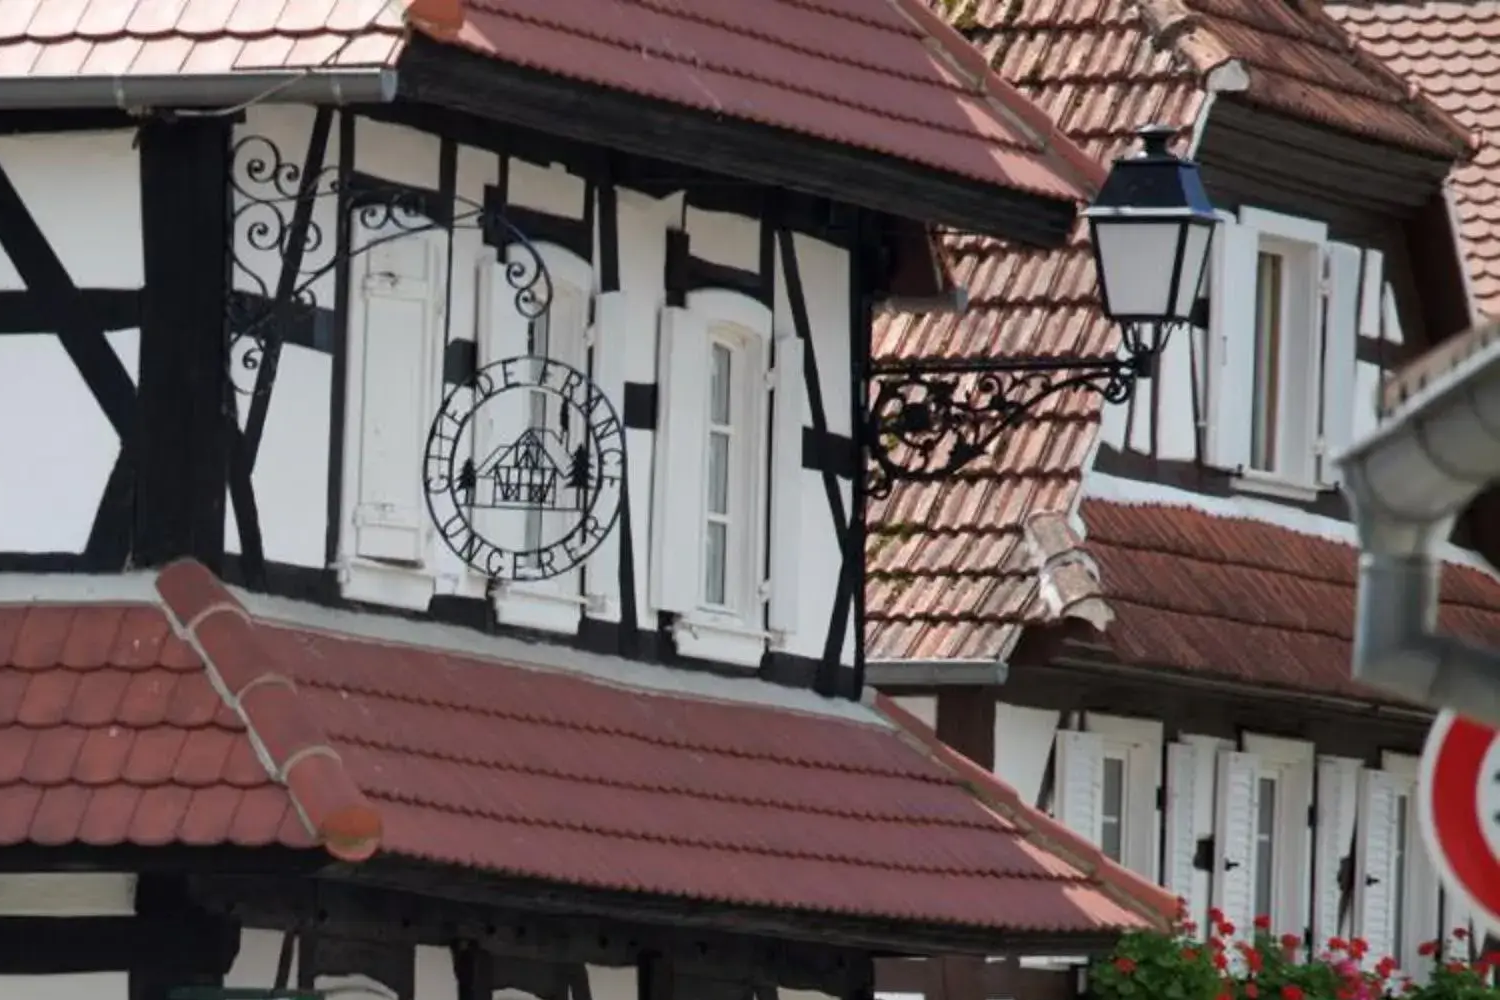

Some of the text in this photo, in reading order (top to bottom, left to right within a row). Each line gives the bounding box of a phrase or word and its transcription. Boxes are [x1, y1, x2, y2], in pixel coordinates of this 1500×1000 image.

[474, 358, 521, 399] DE
[538, 359, 625, 488] FRANCE
[442, 513, 608, 581] UNGERER
